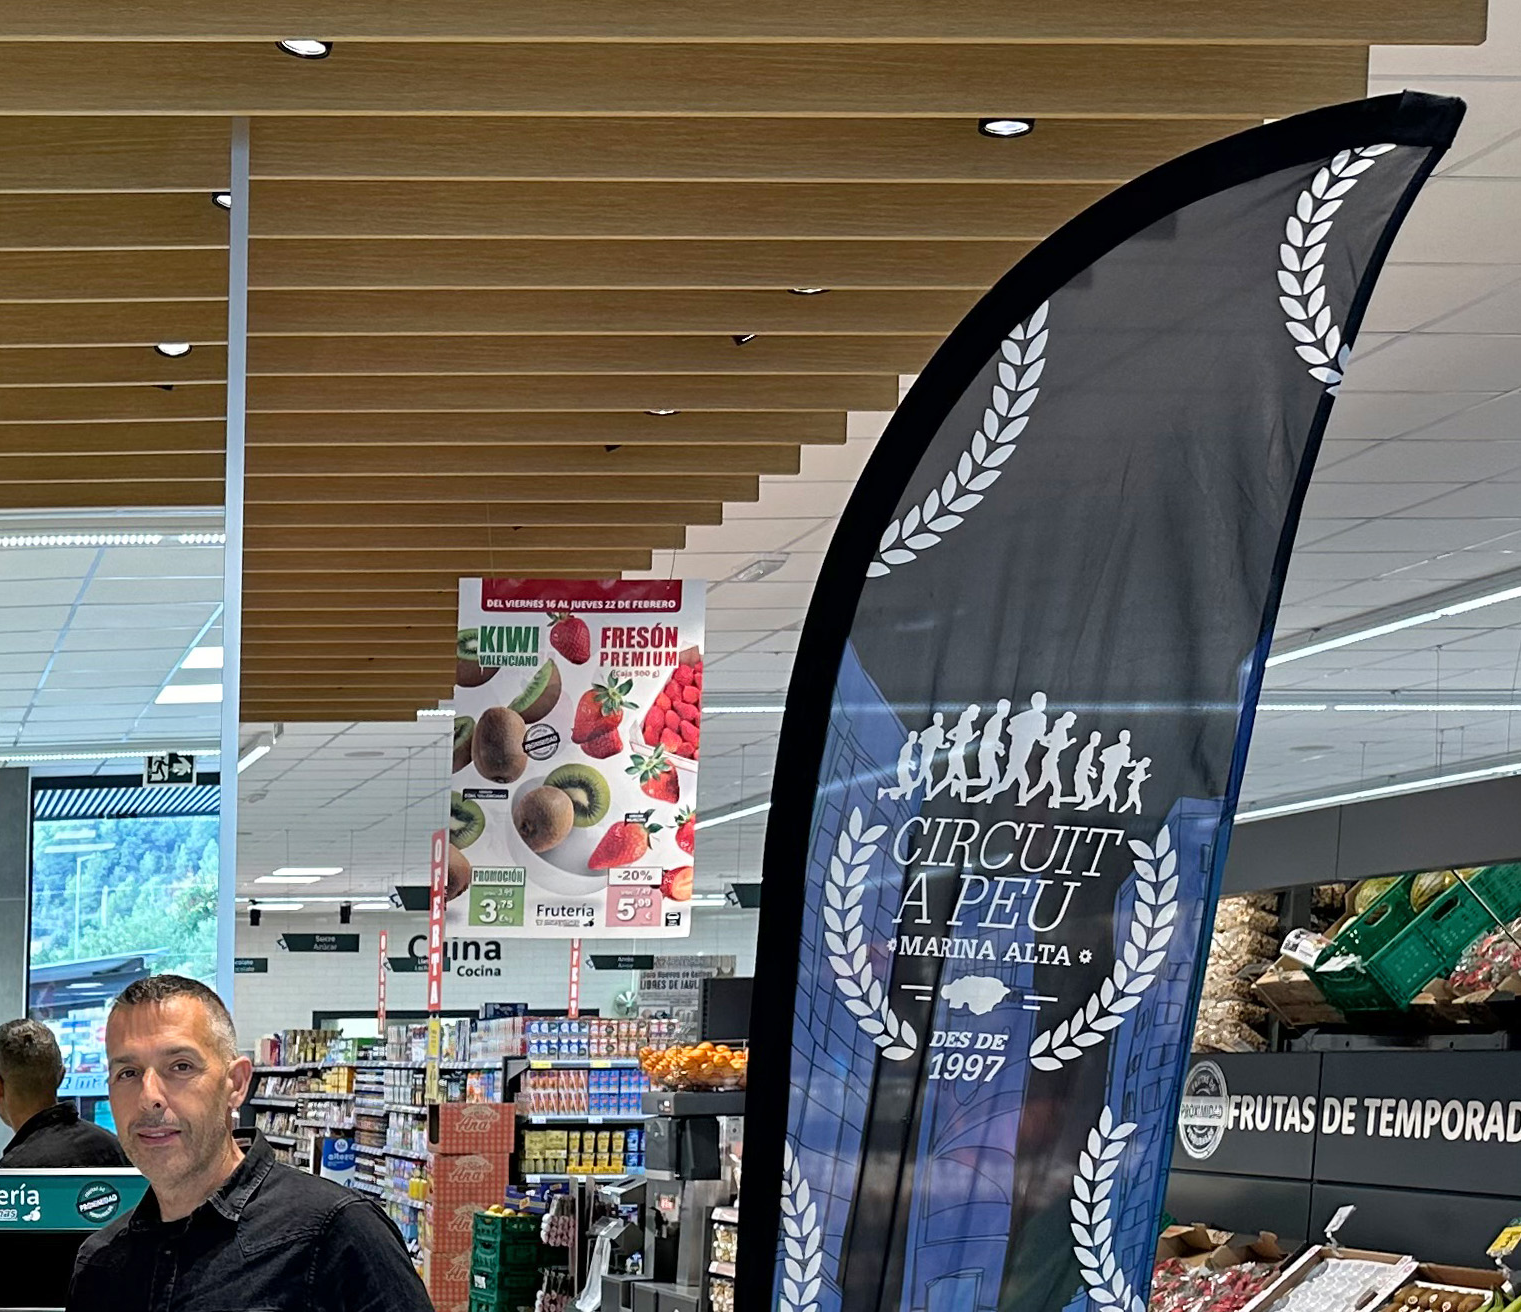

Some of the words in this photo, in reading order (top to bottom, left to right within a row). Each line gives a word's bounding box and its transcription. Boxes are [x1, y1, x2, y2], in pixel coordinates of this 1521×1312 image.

[486, 599, 504, 609] DEL
[506, 599, 544, 609] VIERNES
[545, 599, 556, 609] 16
[557, 599, 569, 609] AL
[570, 600, 603, 610] JUEVES
[604, 600, 616, 609] 22
[617, 600, 629, 609] DE
[631, 600, 676, 609] FEBRERO
[479, 625, 539, 653] KIWI
[600, 622, 679, 649] FRESÓN
[479, 655, 538, 667] VALENCIANO
[599, 651, 678, 667] PREMIUM
[892, 816, 1125, 878] CIRCUIT
[473, 868, 524, 884] PROMOCIÓN
[617, 870, 653, 882] -20%
[536, 903, 595, 918] Frutería
[891, 872, 932, 926] A
[946, 873, 1082, 932] PEU
[429, 838, 442, 1006] OFERTA
[898, 935, 997, 962] MARINA
[1002, 941, 1072, 966] ALTA
[456, 964, 502, 977] Cocina
[929, 1031, 971, 1049] DES
[974, 1033, 1008, 1051] DE
[928, 1053, 1006, 1083] 1997
[457, 1116, 489, 1131] Ana
[1227, 1094, 1316, 1134] FRUTAS
[1321, 1098, 1356, 1136] DE
[450, 1168, 483, 1182] Ana
